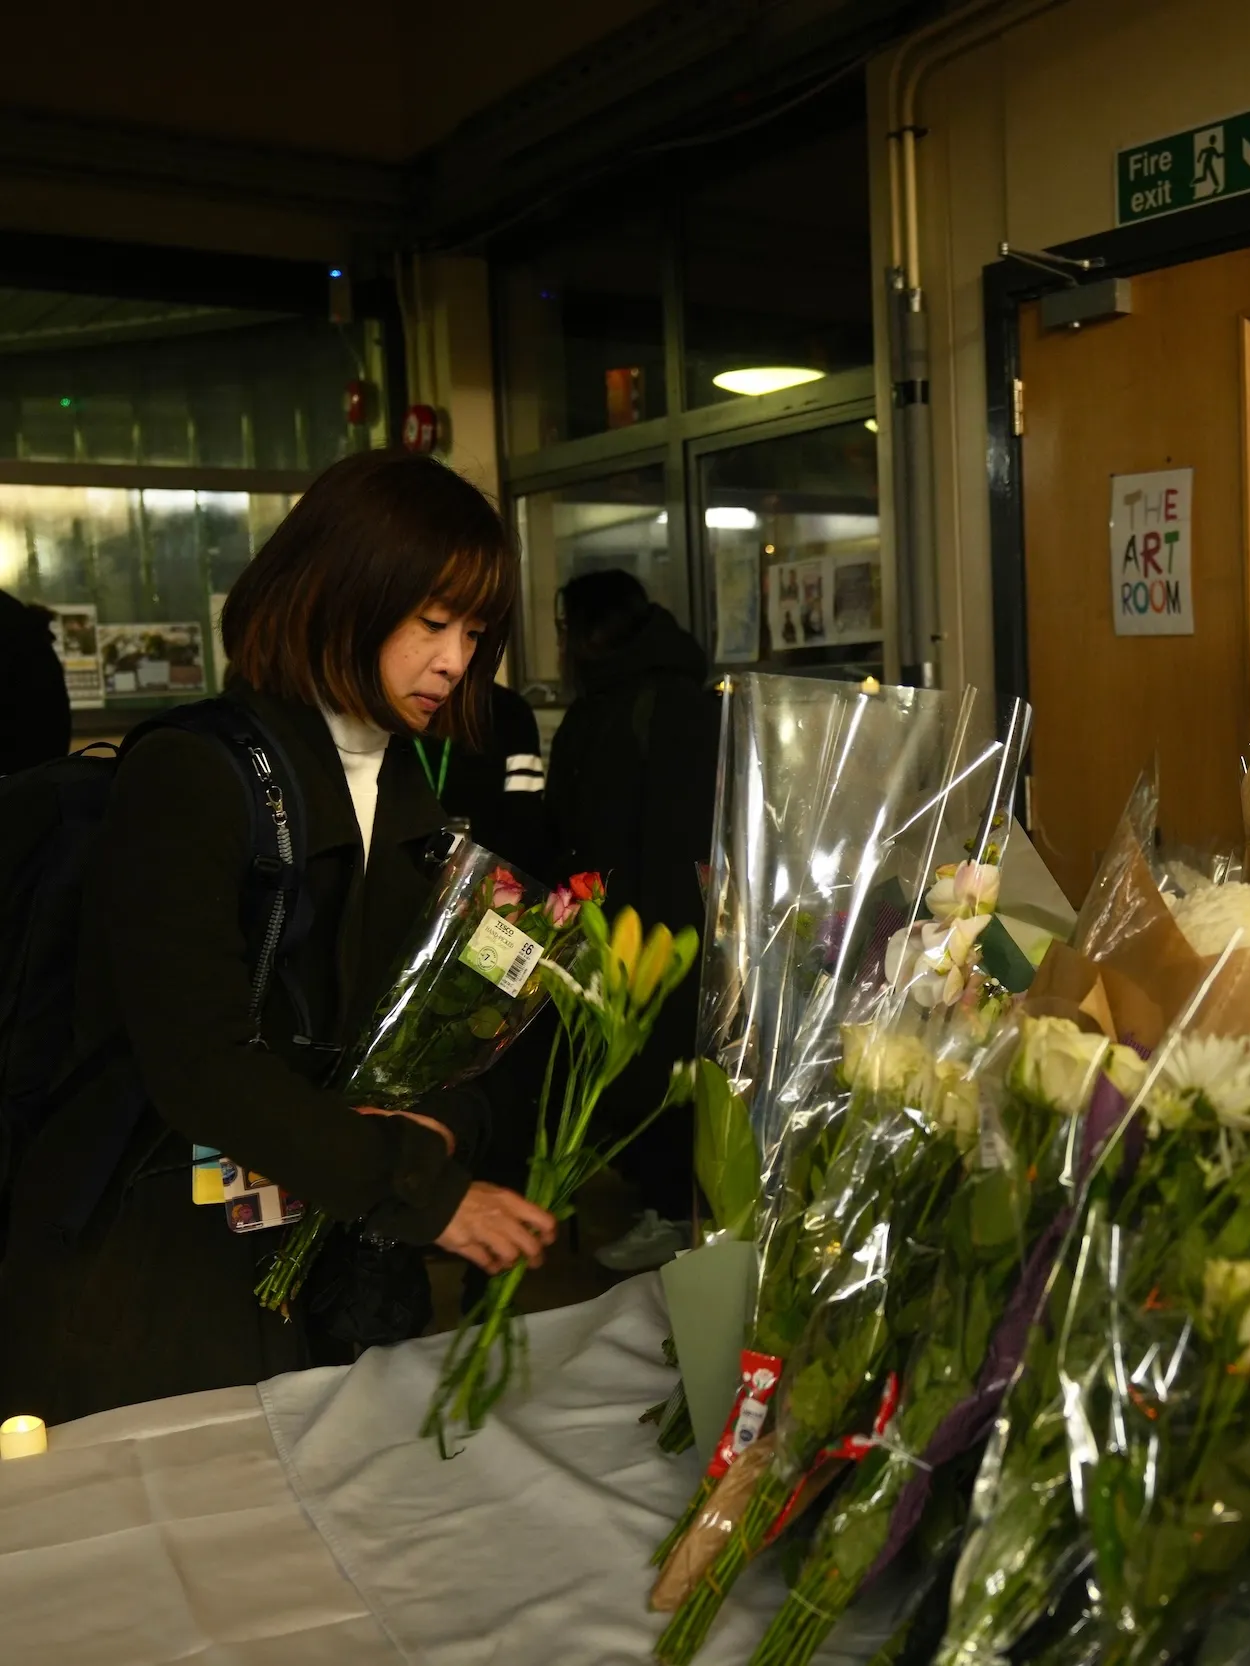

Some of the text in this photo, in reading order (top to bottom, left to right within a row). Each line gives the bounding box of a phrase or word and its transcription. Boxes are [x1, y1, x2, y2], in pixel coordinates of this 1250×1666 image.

[1129, 151, 1172, 181] Fire
[1131, 180, 1172, 212] exit
[1123, 489, 1179, 531] THE
[1122, 531, 1180, 578] ART
[1121, 579, 1181, 615] ROOM
[496, 920, 515, 936] TESCO
[521, 942, 534, 956] £6
